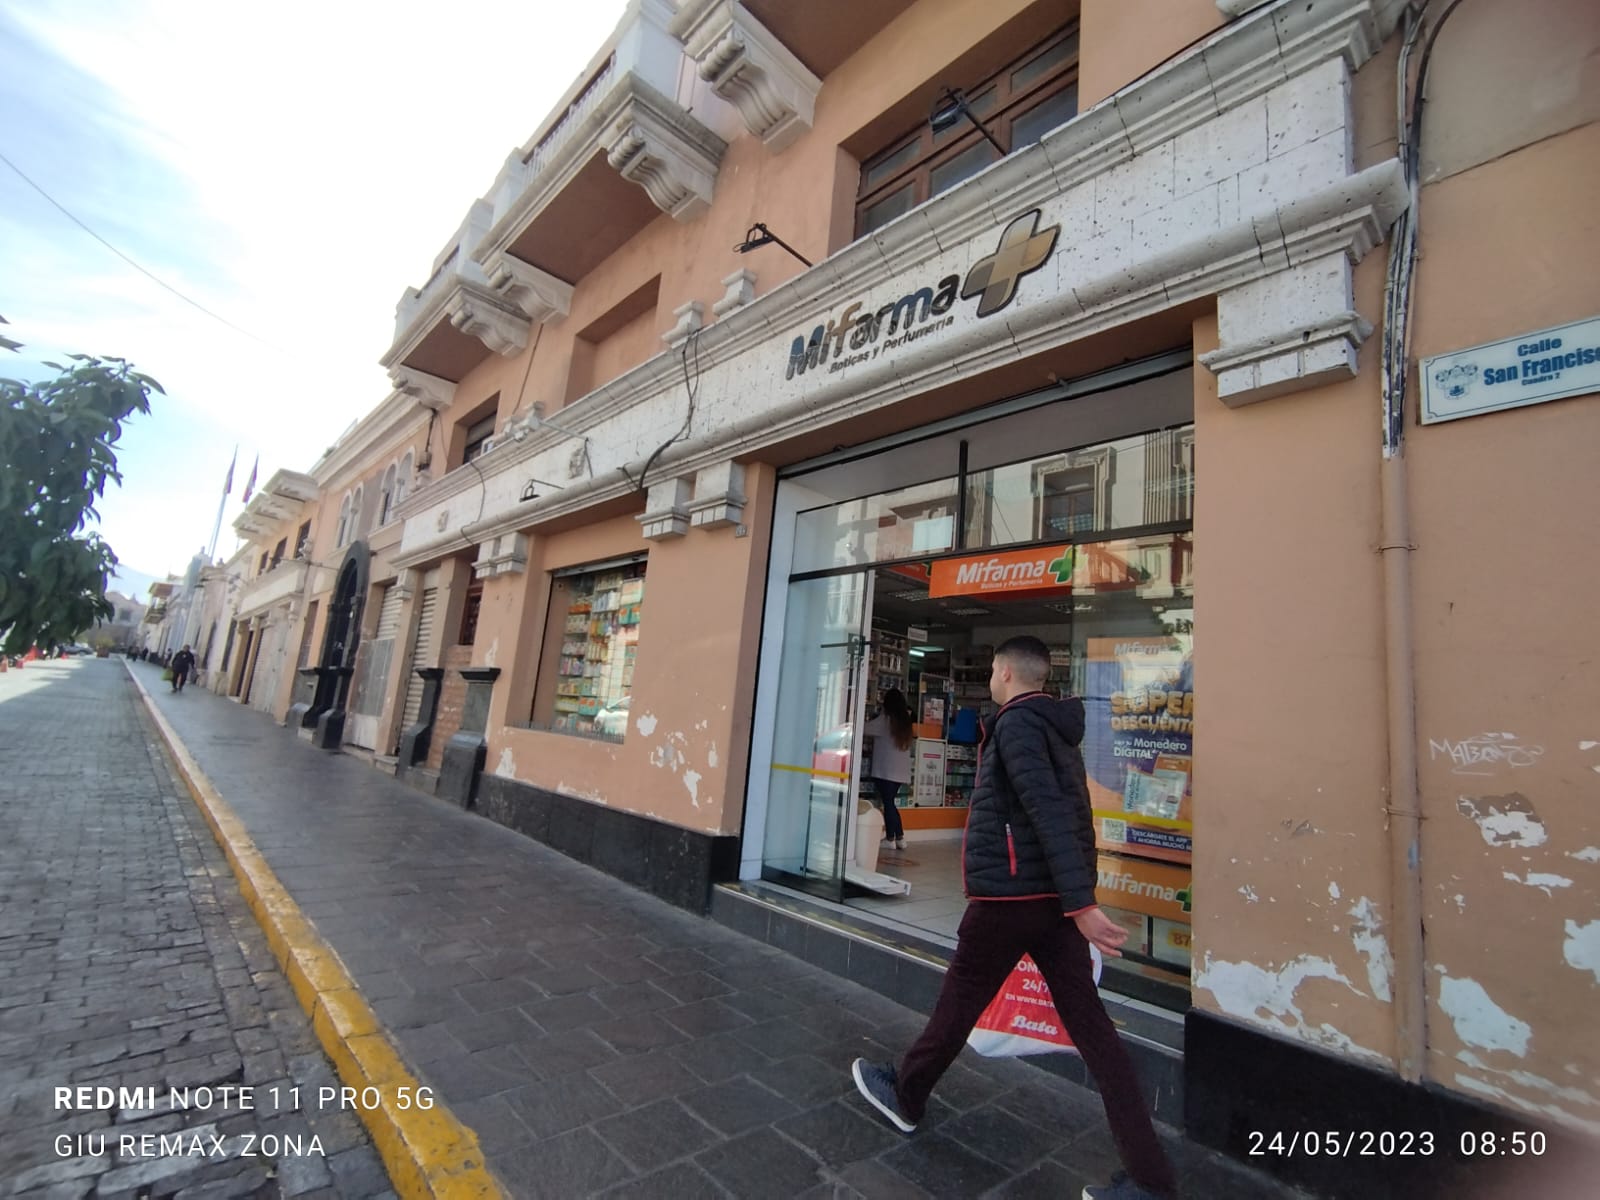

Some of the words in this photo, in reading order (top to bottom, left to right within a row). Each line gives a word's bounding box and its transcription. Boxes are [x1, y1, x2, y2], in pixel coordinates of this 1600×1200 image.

[786, 274, 960, 381] Mifarma
[1517, 337, 1562, 357] Calle
[829, 350, 870, 374] Boticas
[872, 345, 880, 360] y
[1483, 364, 1518, 386] San
[1521, 374, 1554, 386] Cuadra
[956, 558, 1046, 585] Mifarma
[1113, 746, 1154, 759] DIGITAL
[1133, 738, 1187, 751] Monedero
[1097, 869, 1176, 901] Mifarma
[1014, 960, 1041, 975] OM
[1011, 1015, 1058, 1036] Bata
